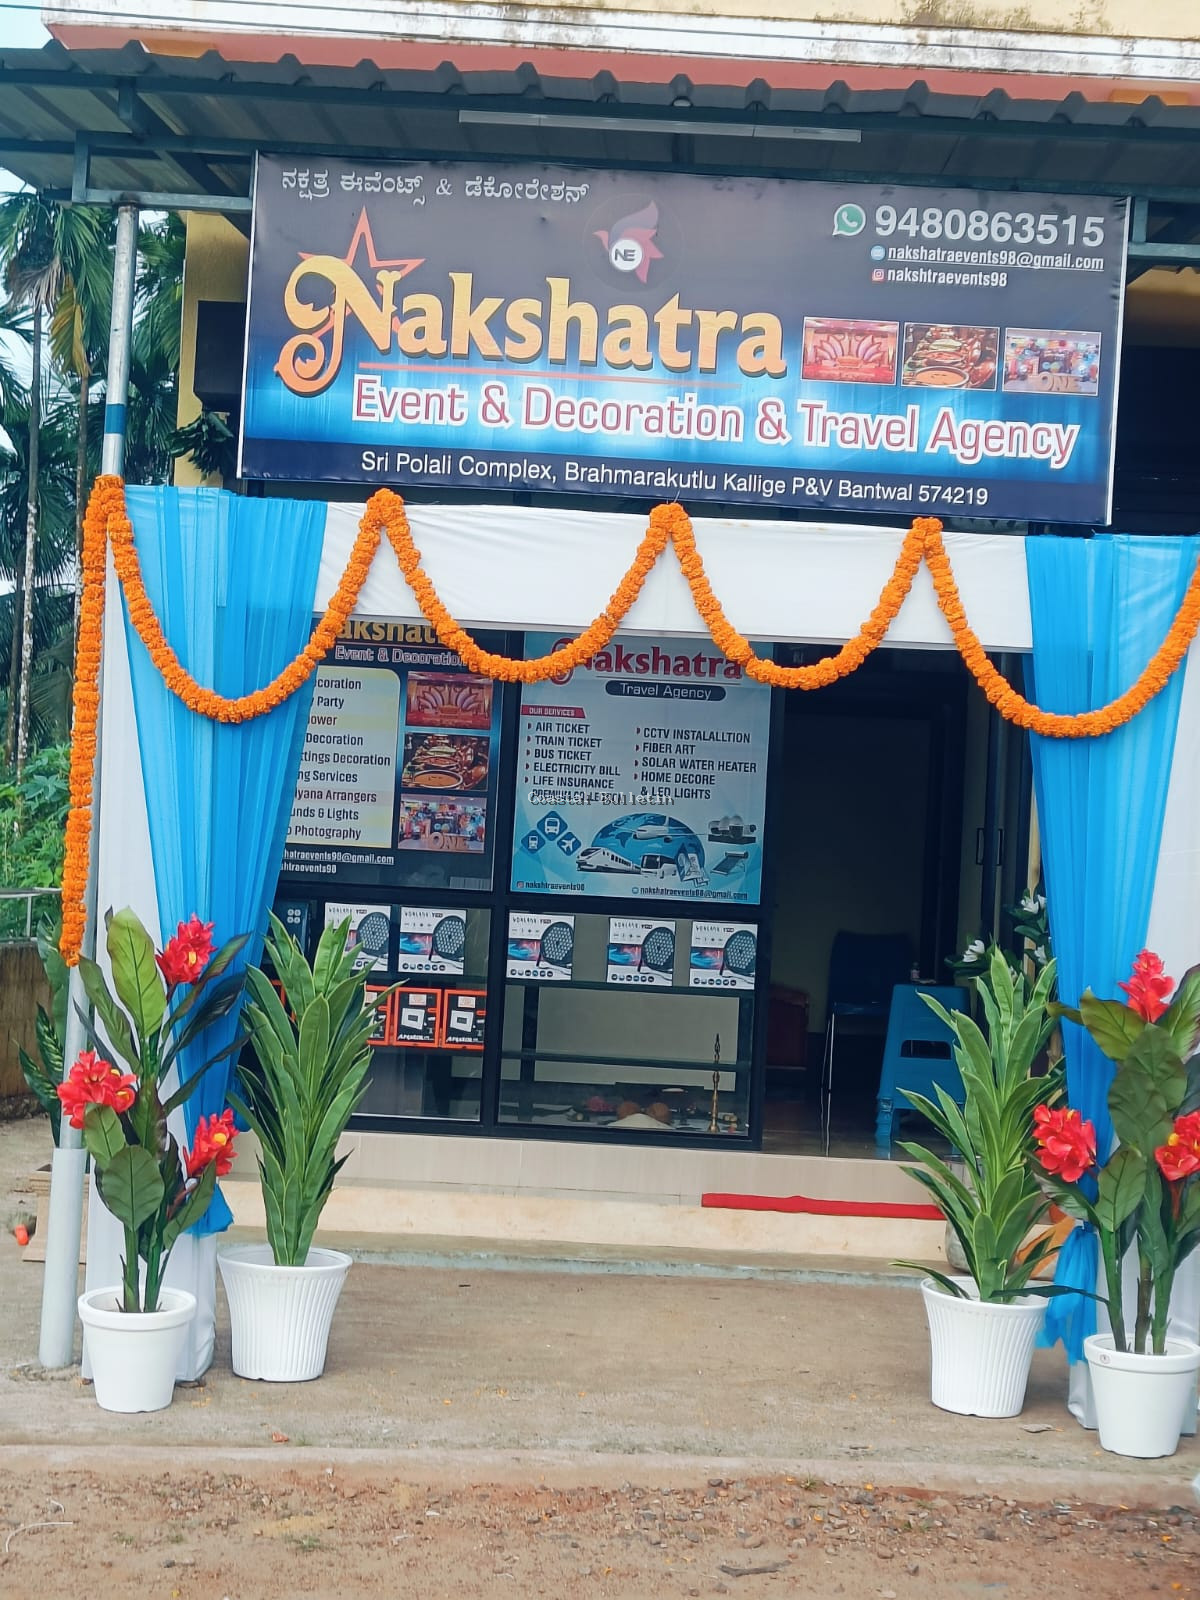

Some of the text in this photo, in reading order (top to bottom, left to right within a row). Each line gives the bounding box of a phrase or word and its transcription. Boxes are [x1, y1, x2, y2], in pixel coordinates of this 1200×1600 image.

[282, 168, 589, 206] ನಕ್ಷತ್ರ ಈವೆಂಟ್ಸ್ & ಡೆಕೋರೇಶನ್
[875, 205, 1105, 247] 9480863515
[888, 245, 1105, 271] nakshatraevents98@gmail.com
[887, 267, 1008, 287] nakshtraevents98
[274, 254, 787, 397] Nakshatra
[353, 374, 1080, 469] Event & Decoration & Travel Agency
[361, 450, 989, 505] Sri Polali Complex, Brahmarakutlu Kallige P&V Bantwal 574219
[335, 645, 374, 661] Event
[378, 648, 389, 662] &
[620, 682, 712, 700] Travel Agency
[317, 696, 344, 709] Party
[536, 722, 590, 734] AIR TICKET
[644, 727, 669, 739] CCTV
[306, 733, 363, 746] Decoration
[535, 735, 602, 748] TRAIN TICKET
[534, 749, 592, 761] BUS TICKET
[643, 742, 696, 755] FIBER ART
[333, 753, 391, 766] Decoration
[642, 757, 757, 773] SOLAR WATER HEATER
[534, 762, 620, 776] ELECTRICITY BILL
[312, 770, 358, 782] Services
[533, 776, 615, 789] LIFE INSURANCE
[641, 771, 715, 785] HOME DECORE
[326, 790, 377, 803] Arrangers
[674, 787, 711, 799] LIGHTS
[327, 808, 359, 821] Lights
[295, 825, 361, 840] Photography
